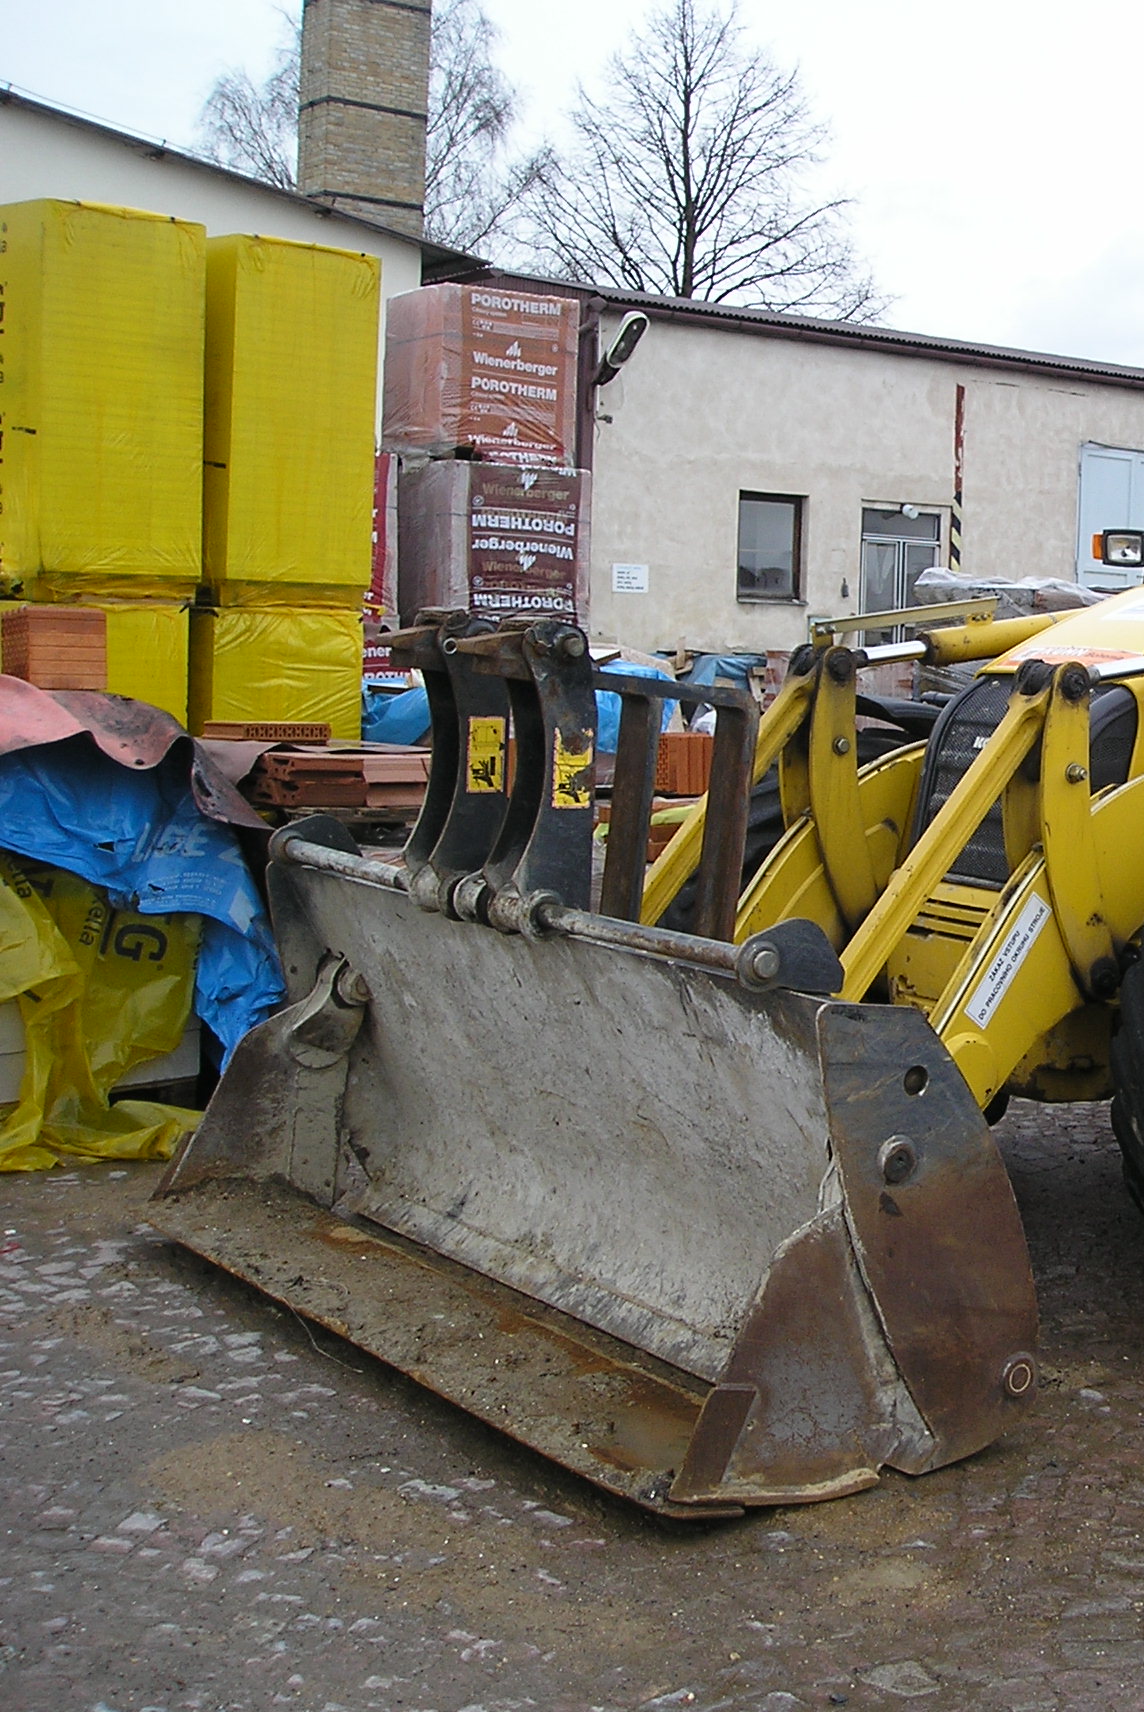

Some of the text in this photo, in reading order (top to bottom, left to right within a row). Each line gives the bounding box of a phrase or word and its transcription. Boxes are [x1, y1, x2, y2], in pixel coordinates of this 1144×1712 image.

[471, 293, 561, 315] POROTHERM
[473, 351, 558, 376] Wienerberger
[471, 376, 557, 400] POROTHERM
[472, 514, 575, 536] POROTHERM
[472, 537, 574, 560] Wienerberger
[978, 1008, 987, 1020] DO
